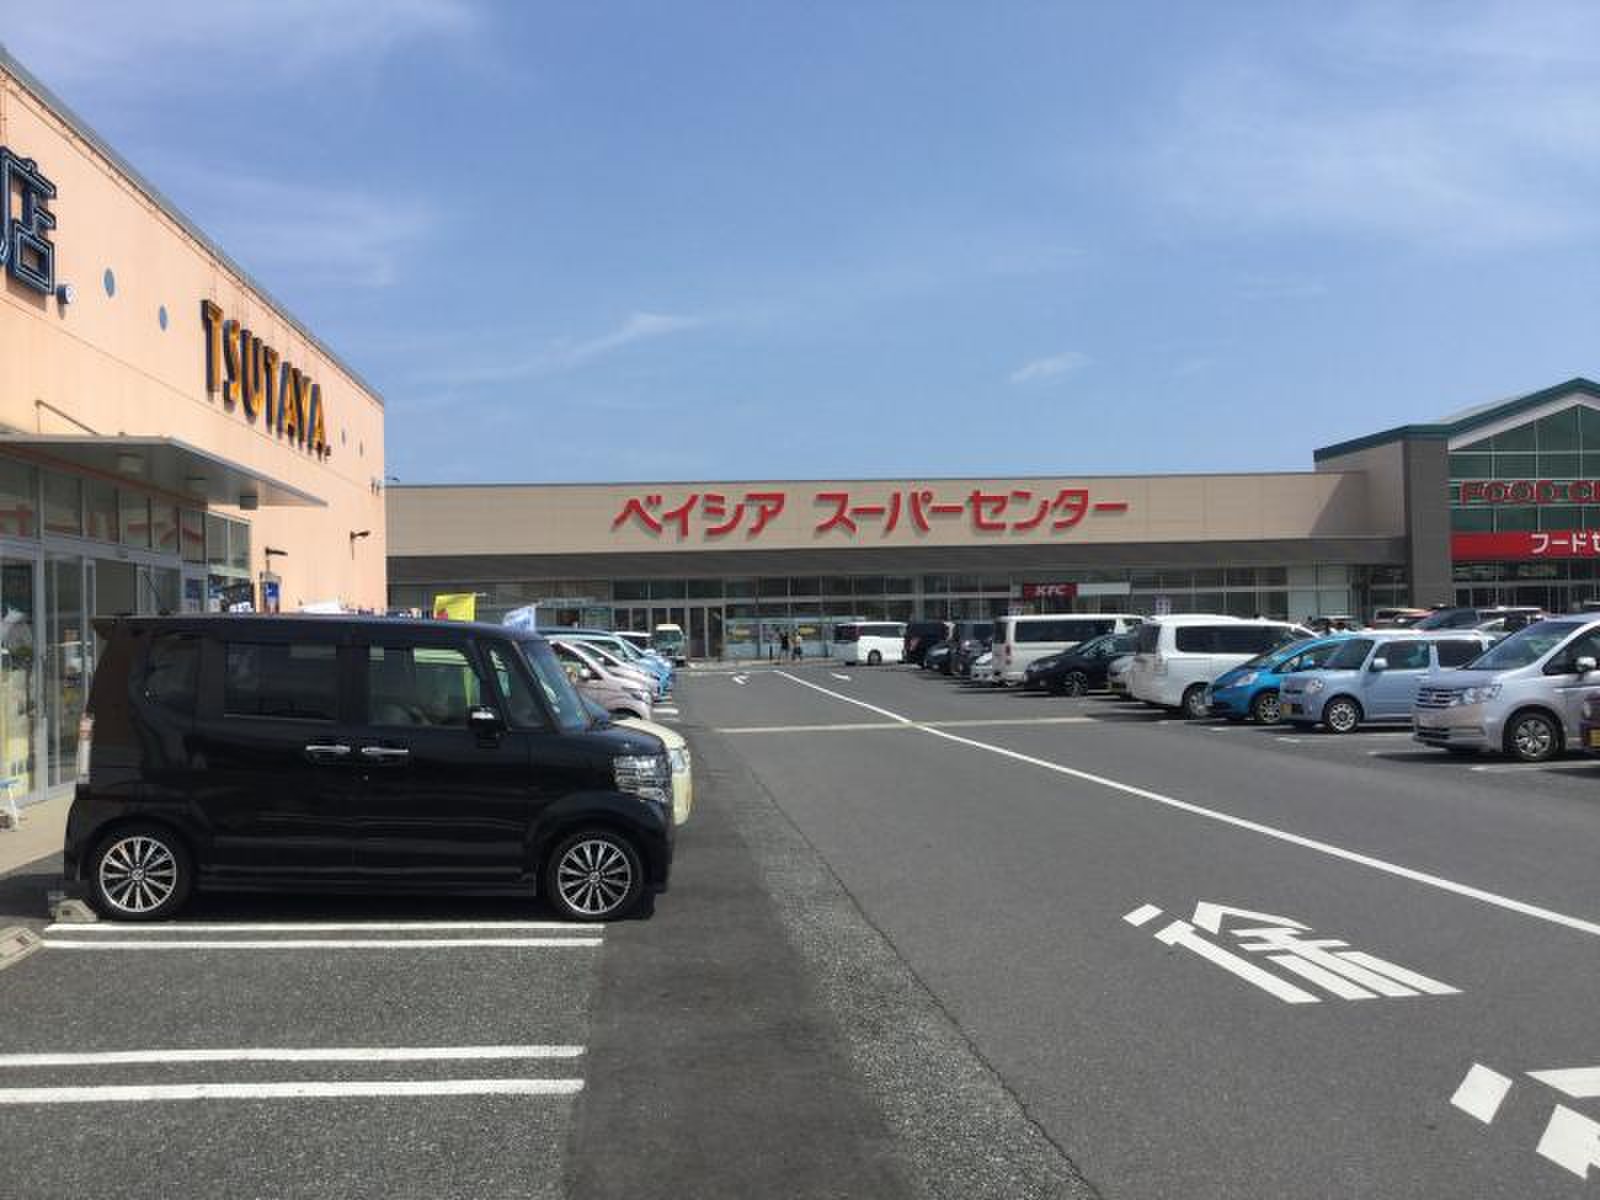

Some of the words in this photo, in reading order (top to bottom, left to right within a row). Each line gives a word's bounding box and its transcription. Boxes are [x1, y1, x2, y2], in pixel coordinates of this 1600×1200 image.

[1460, 480, 1560, 505] FOOD
[612, 492, 787, 537] ベイシア
[814, 489, 1129, 533] スーパーセンター
[1034, 585, 1067, 597] KFC
